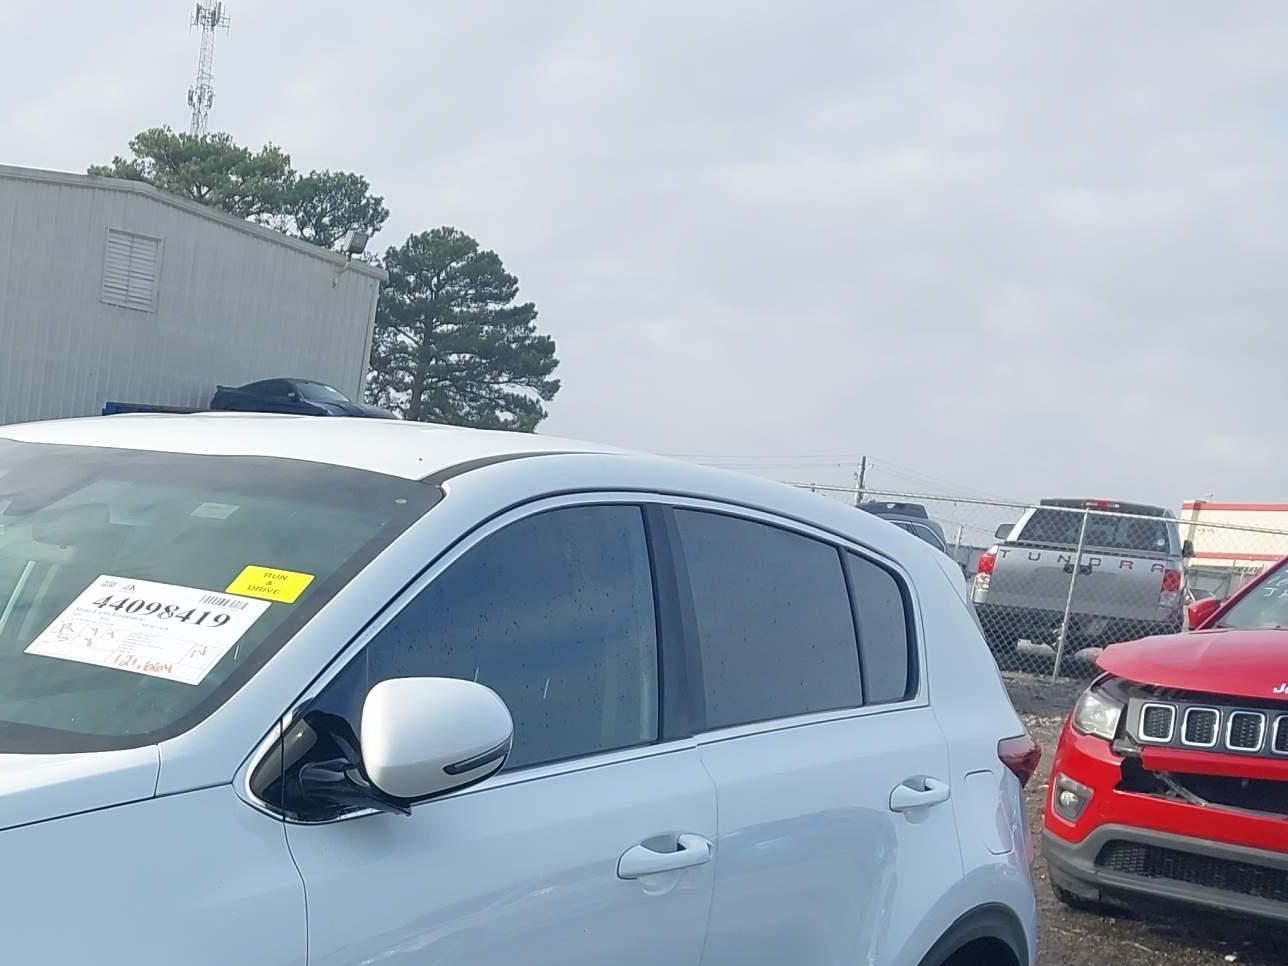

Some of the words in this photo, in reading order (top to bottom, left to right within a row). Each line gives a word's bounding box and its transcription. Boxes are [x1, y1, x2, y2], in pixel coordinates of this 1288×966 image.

[1000, 548, 1165, 573] TUNDRA
[263, 572, 289, 581] RUN
[247, 585, 281, 595] DRIVE
[92, 594, 232, 628] 44098419
